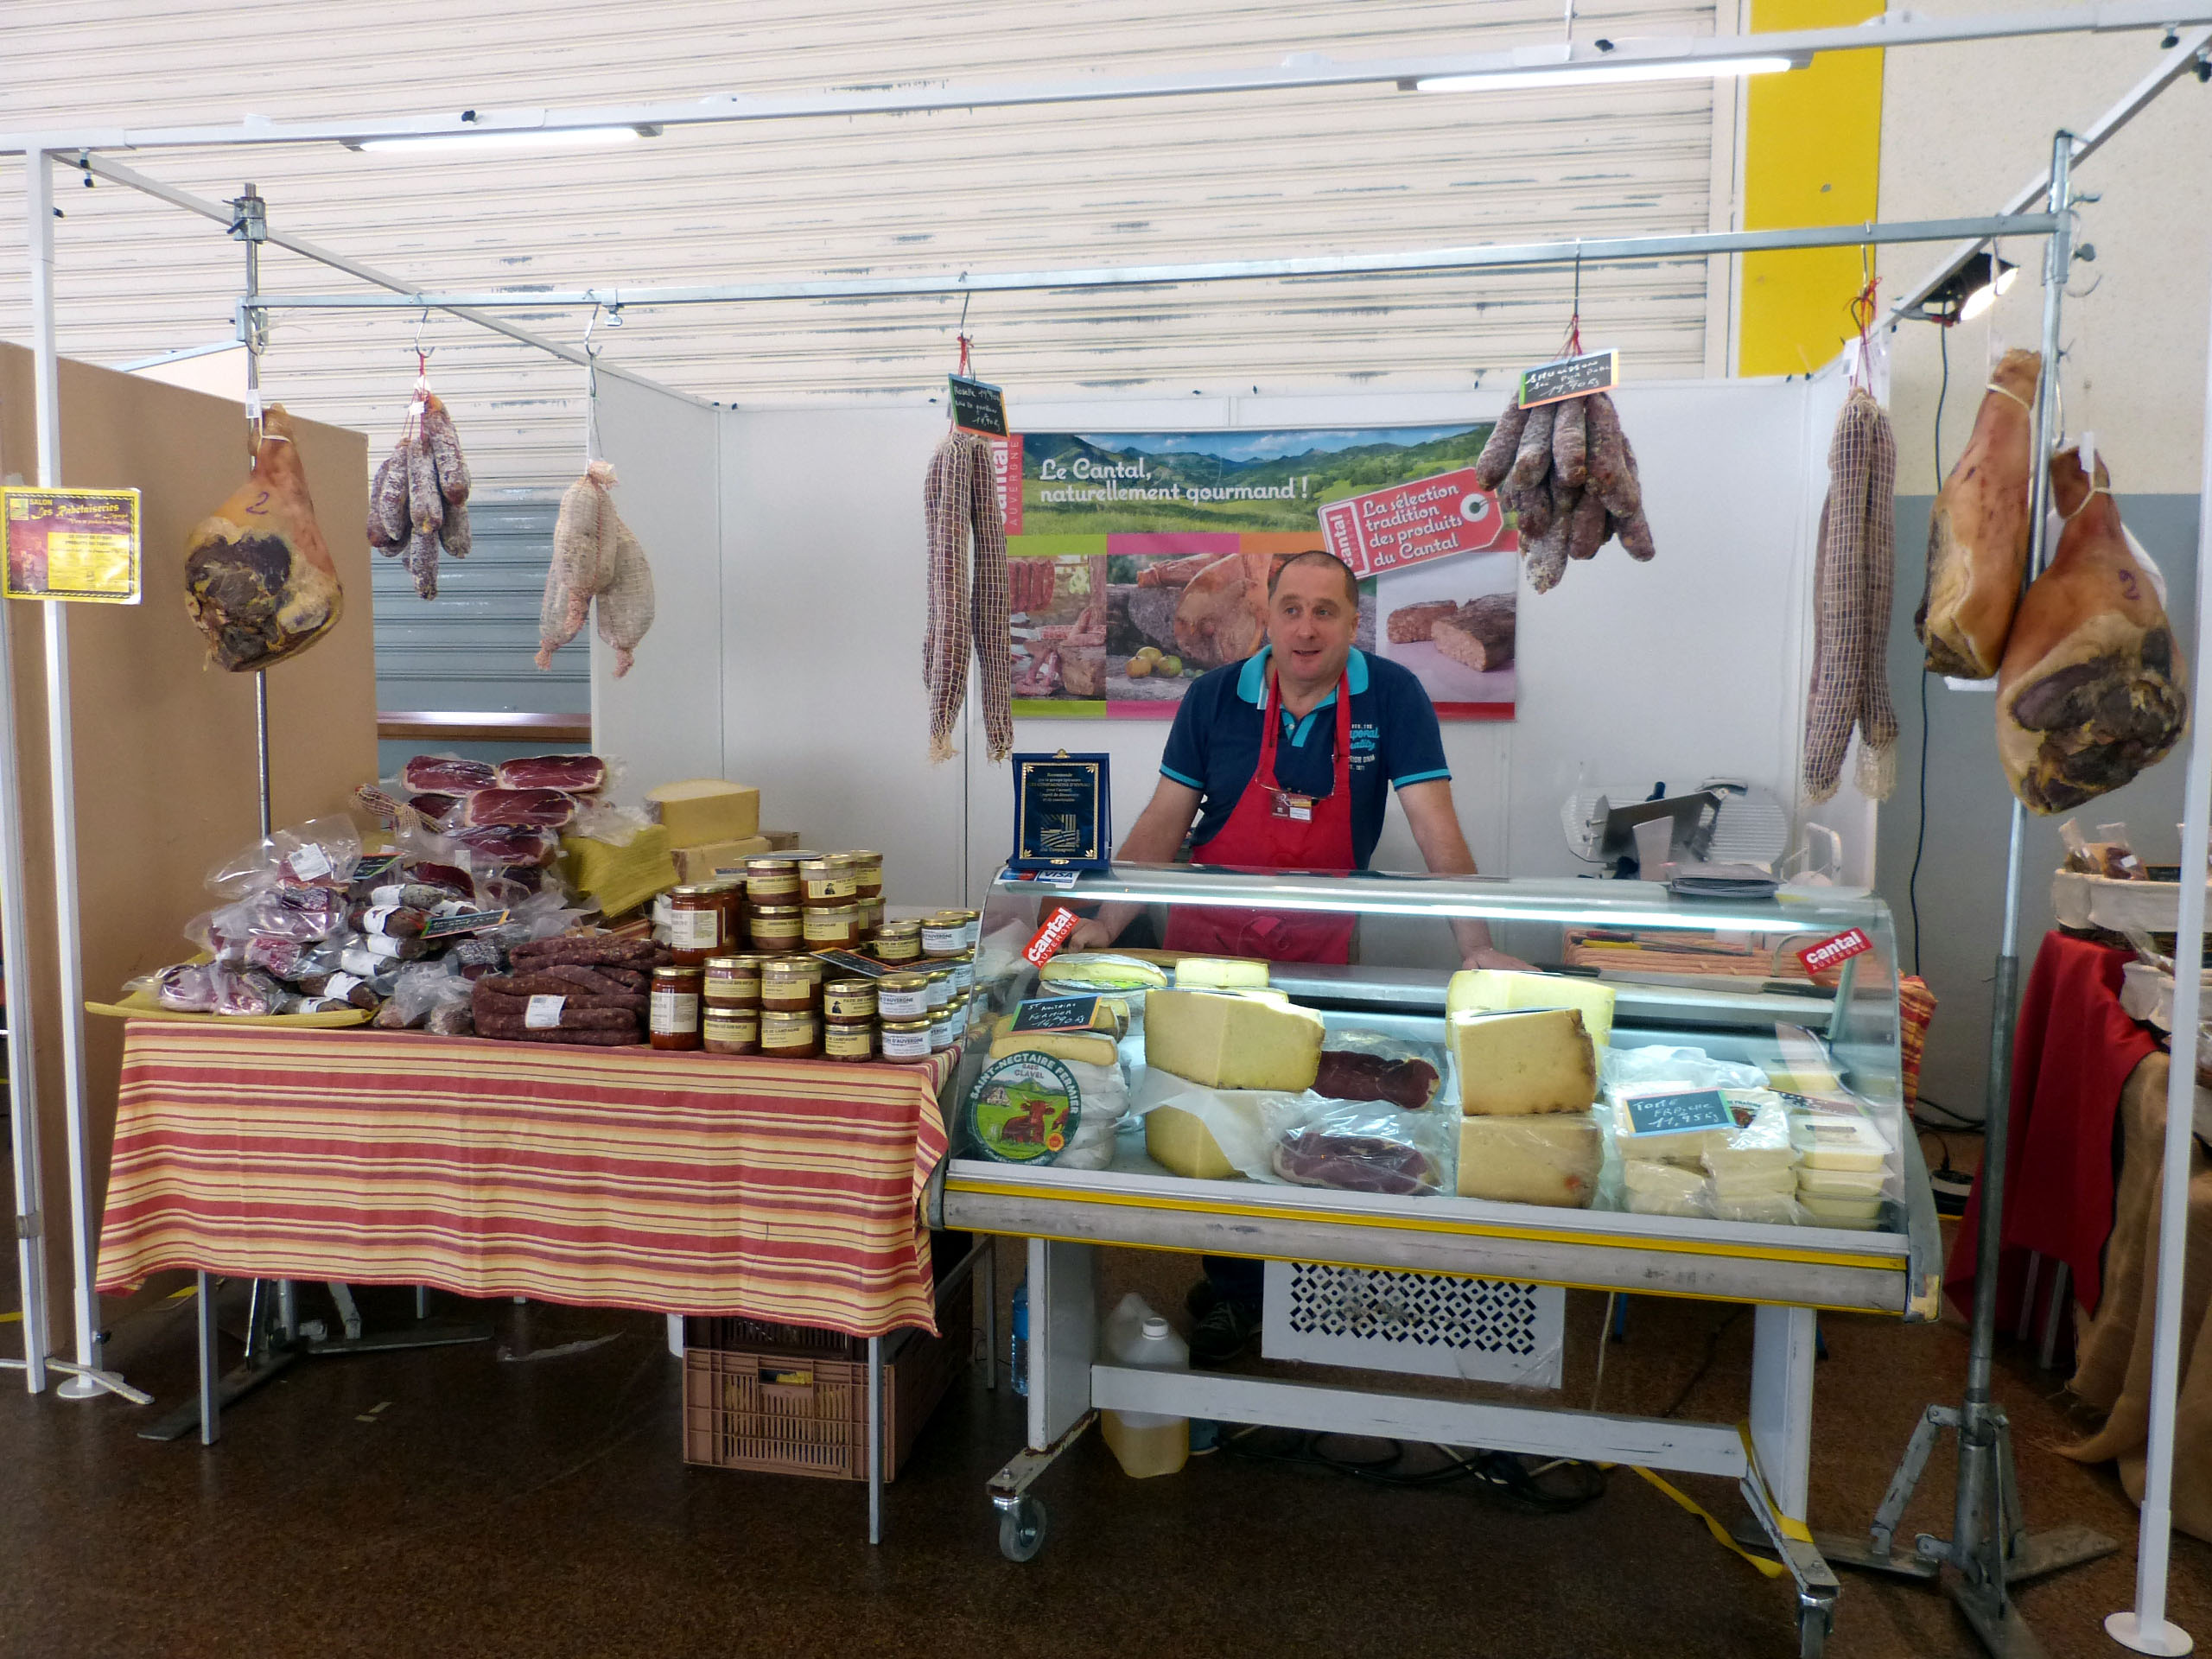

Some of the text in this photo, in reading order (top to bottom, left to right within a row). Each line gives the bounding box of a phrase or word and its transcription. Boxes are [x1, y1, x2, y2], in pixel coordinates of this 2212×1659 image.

[1009, 442, 1020, 526] AUVERGNE
[1039, 457, 1152, 480] Le Cantal,
[245, 491, 270, 515] 2
[1040, 480, 1180, 502] naturellement
[1186, 477, 1296, 506] gourmand
[1363, 485, 1459, 518] La sélection
[1365, 504, 1440, 532] tradition
[1370, 514, 1463, 549] des produits
[1374, 532, 1459, 567] du Cantal
[1350, 727, 1380, 741] poral
[1037, 916, 1077, 967] AUVERGNE
[1806, 931, 1862, 964] cantal
[1812, 943, 1866, 970] AUVERGNE
[969, 1053, 1080, 1115] SAINT-NECTAIRE FERMIER
[1014, 1069, 1045, 1079] CLAVEL
